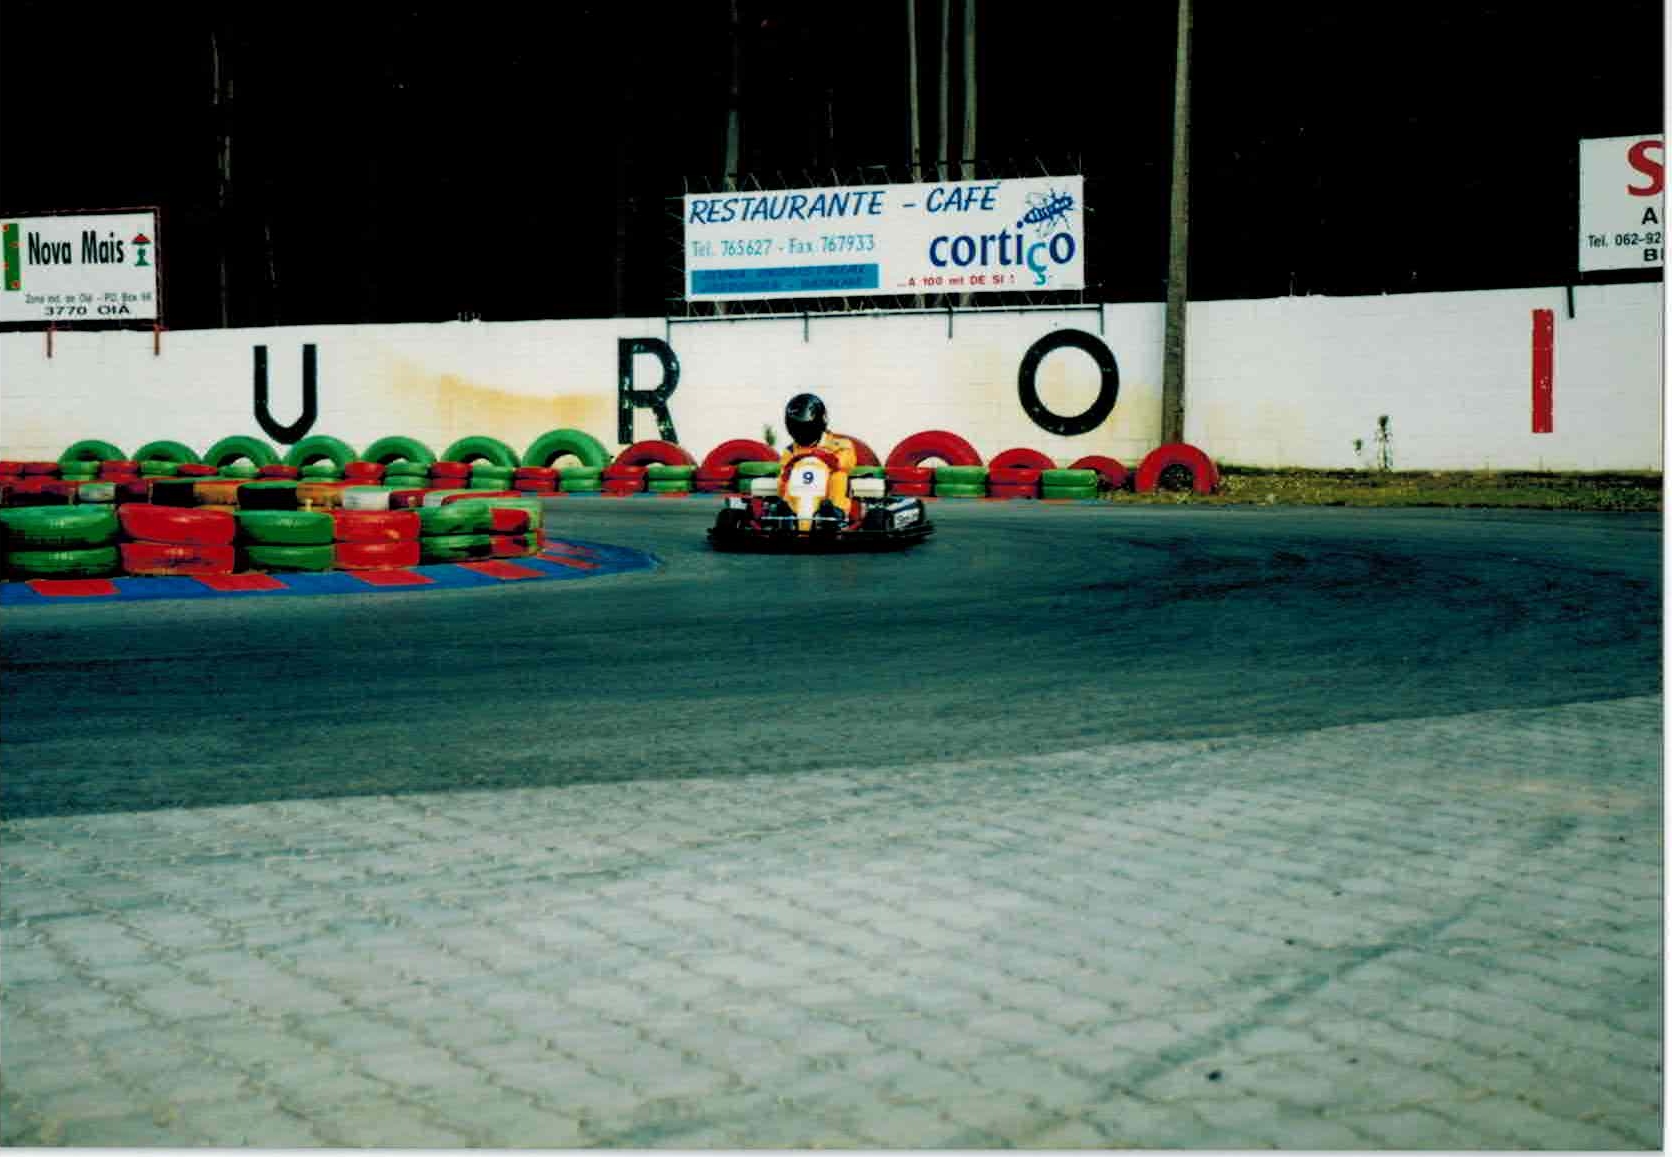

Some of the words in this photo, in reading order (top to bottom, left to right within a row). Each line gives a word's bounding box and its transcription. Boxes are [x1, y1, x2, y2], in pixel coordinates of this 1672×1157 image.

[690, 191, 885, 224] RESTAURANTE
[27, 231, 72, 265] Nova
[81, 230, 125, 264] Mais
[720, 239, 772, 256] 765627
[820, 233, 875, 252] 767933
[1588, 235, 1609, 248] Tel.
[969, 275, 986, 285] DE
[44, 306, 88, 316] 3770
[802, 471, 814, 485] 9
